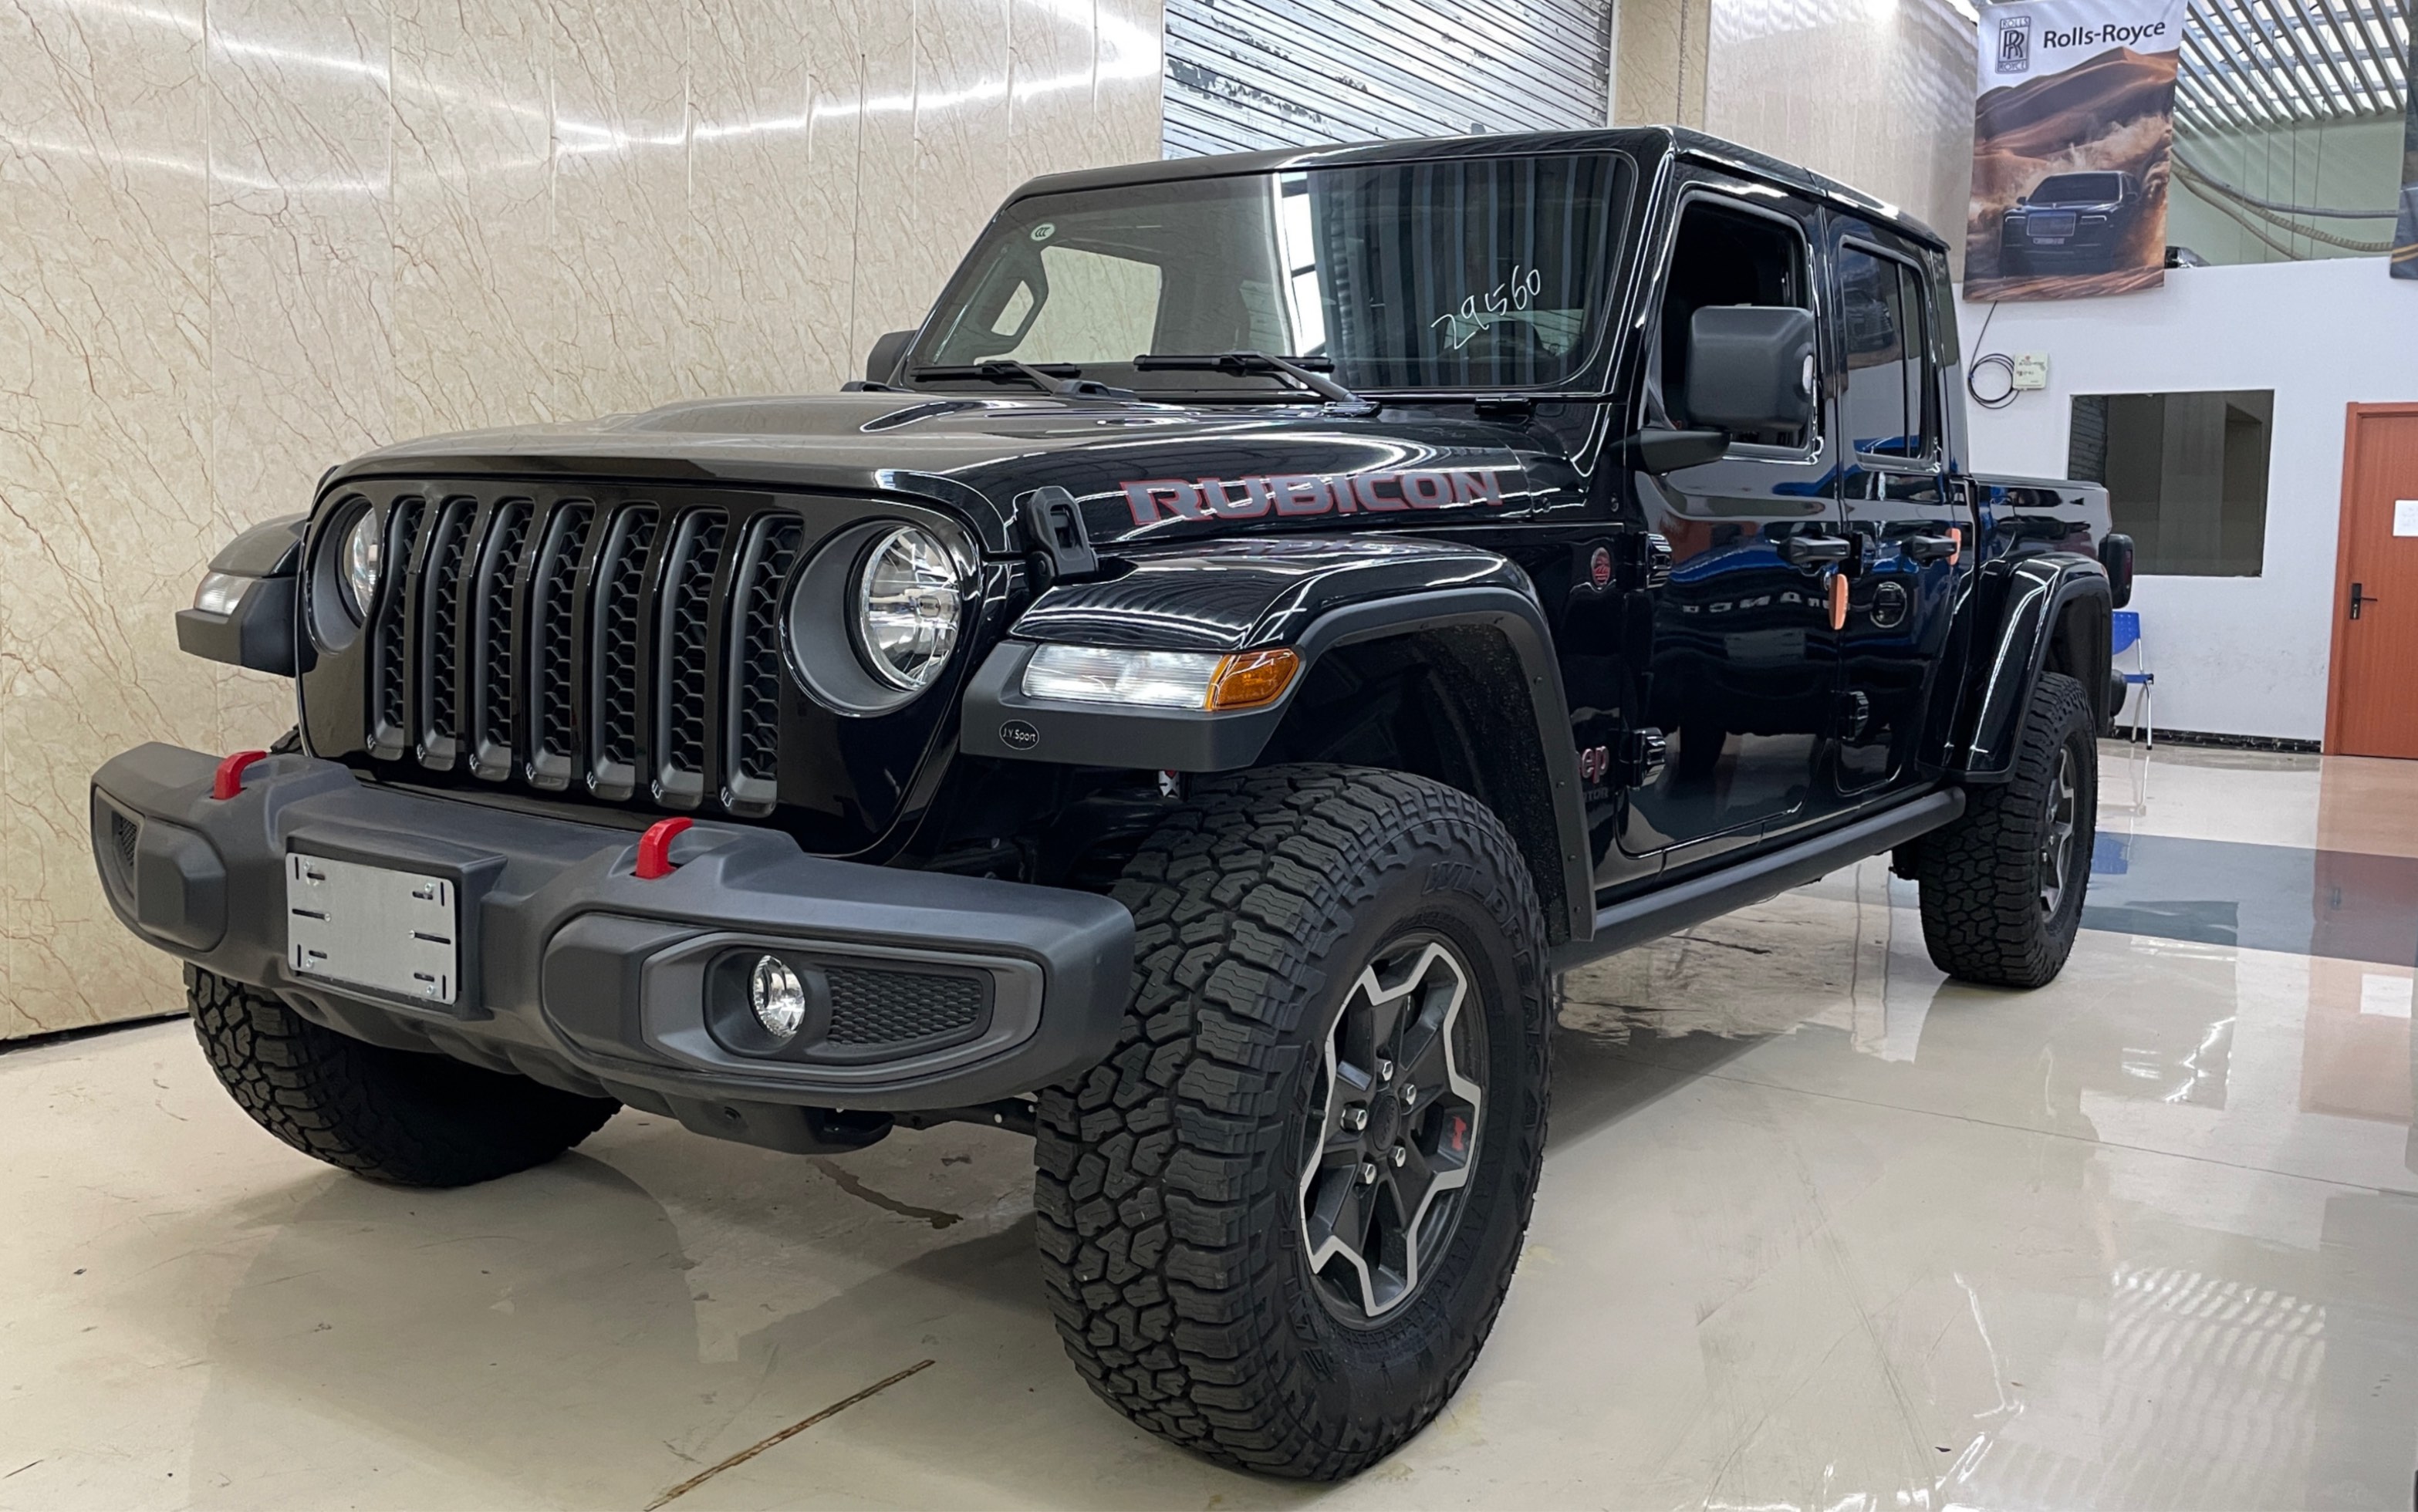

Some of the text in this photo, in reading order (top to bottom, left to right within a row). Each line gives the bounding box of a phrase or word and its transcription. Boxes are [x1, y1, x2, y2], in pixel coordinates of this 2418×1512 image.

[2043, 22, 2166, 49] Rolls-Royce
[1430, 265, 1541, 349] 29560
[1119, 471, 1504, 526] RUBICON
